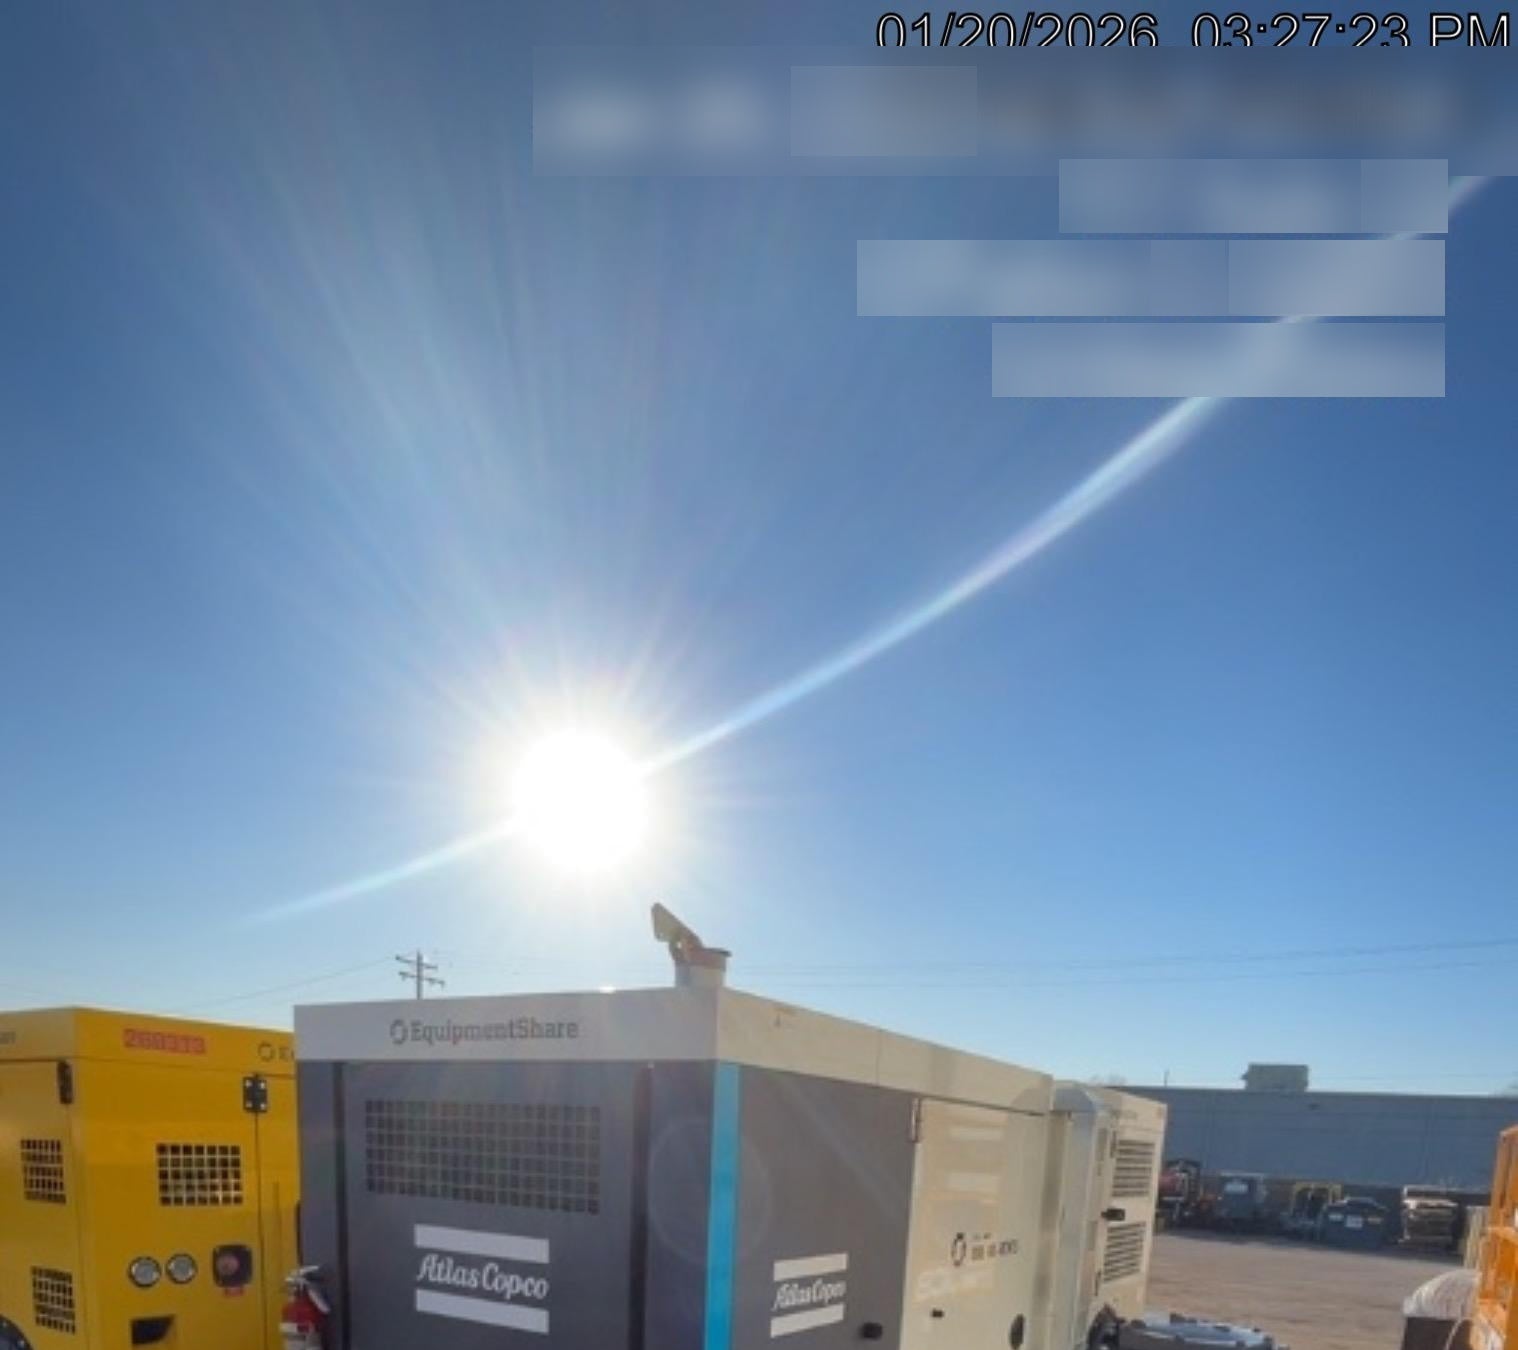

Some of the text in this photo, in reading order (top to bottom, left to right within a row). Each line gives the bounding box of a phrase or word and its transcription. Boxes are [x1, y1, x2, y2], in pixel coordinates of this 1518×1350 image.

[410, 1016, 579, 1046] EquipmentShare
[416, 1253, 549, 1300] Atlas Copco
